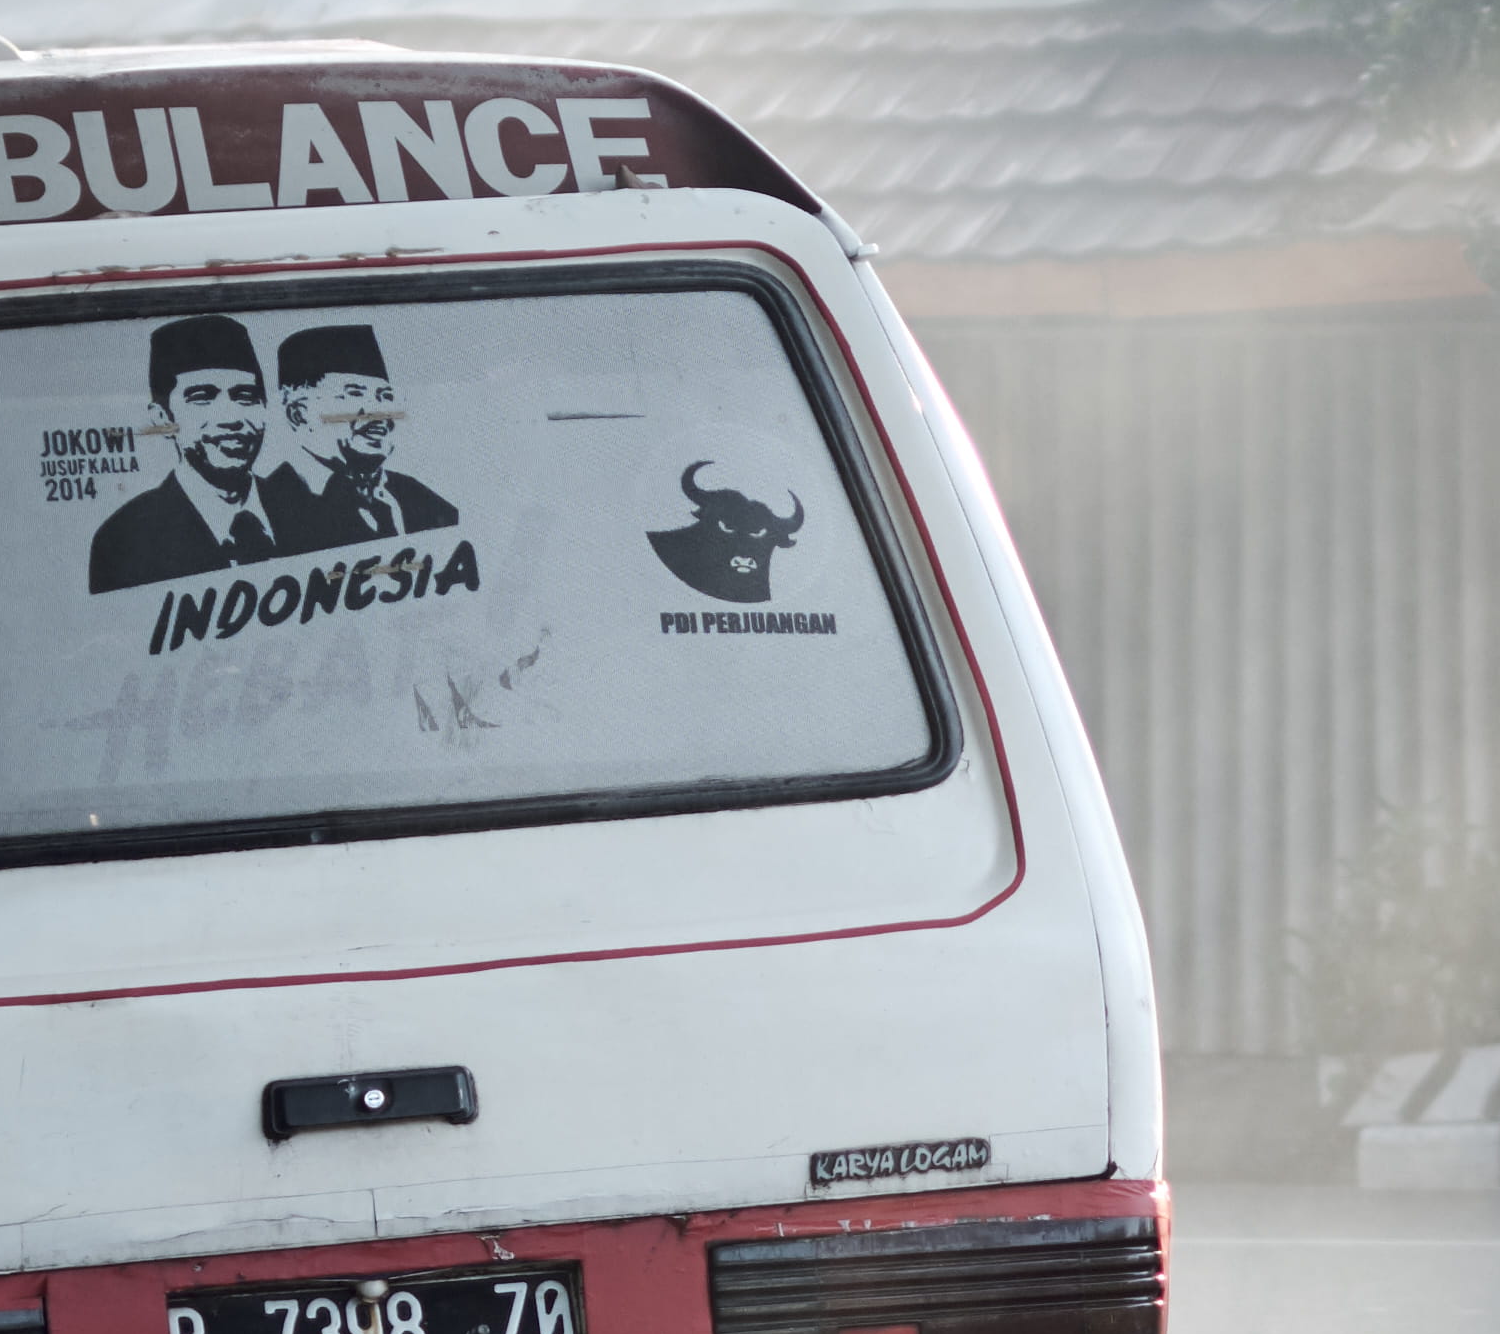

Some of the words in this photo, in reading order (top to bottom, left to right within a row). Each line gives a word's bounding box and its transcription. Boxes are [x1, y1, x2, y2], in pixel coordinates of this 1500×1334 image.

[41, 426, 135, 458] JOKOWI
[40, 459, 86, 477] JUSUF
[88, 456, 140, 474] KALLA
[45, 476, 97, 502] 2014
[148, 541, 480, 655] INDONESIA
[660, 612, 697, 635] PDI
[702, 612, 837, 635] PERJUANGAN
[816, 1150, 895, 1180] KARYA
[900, 1143, 988, 1174] LOGAM
